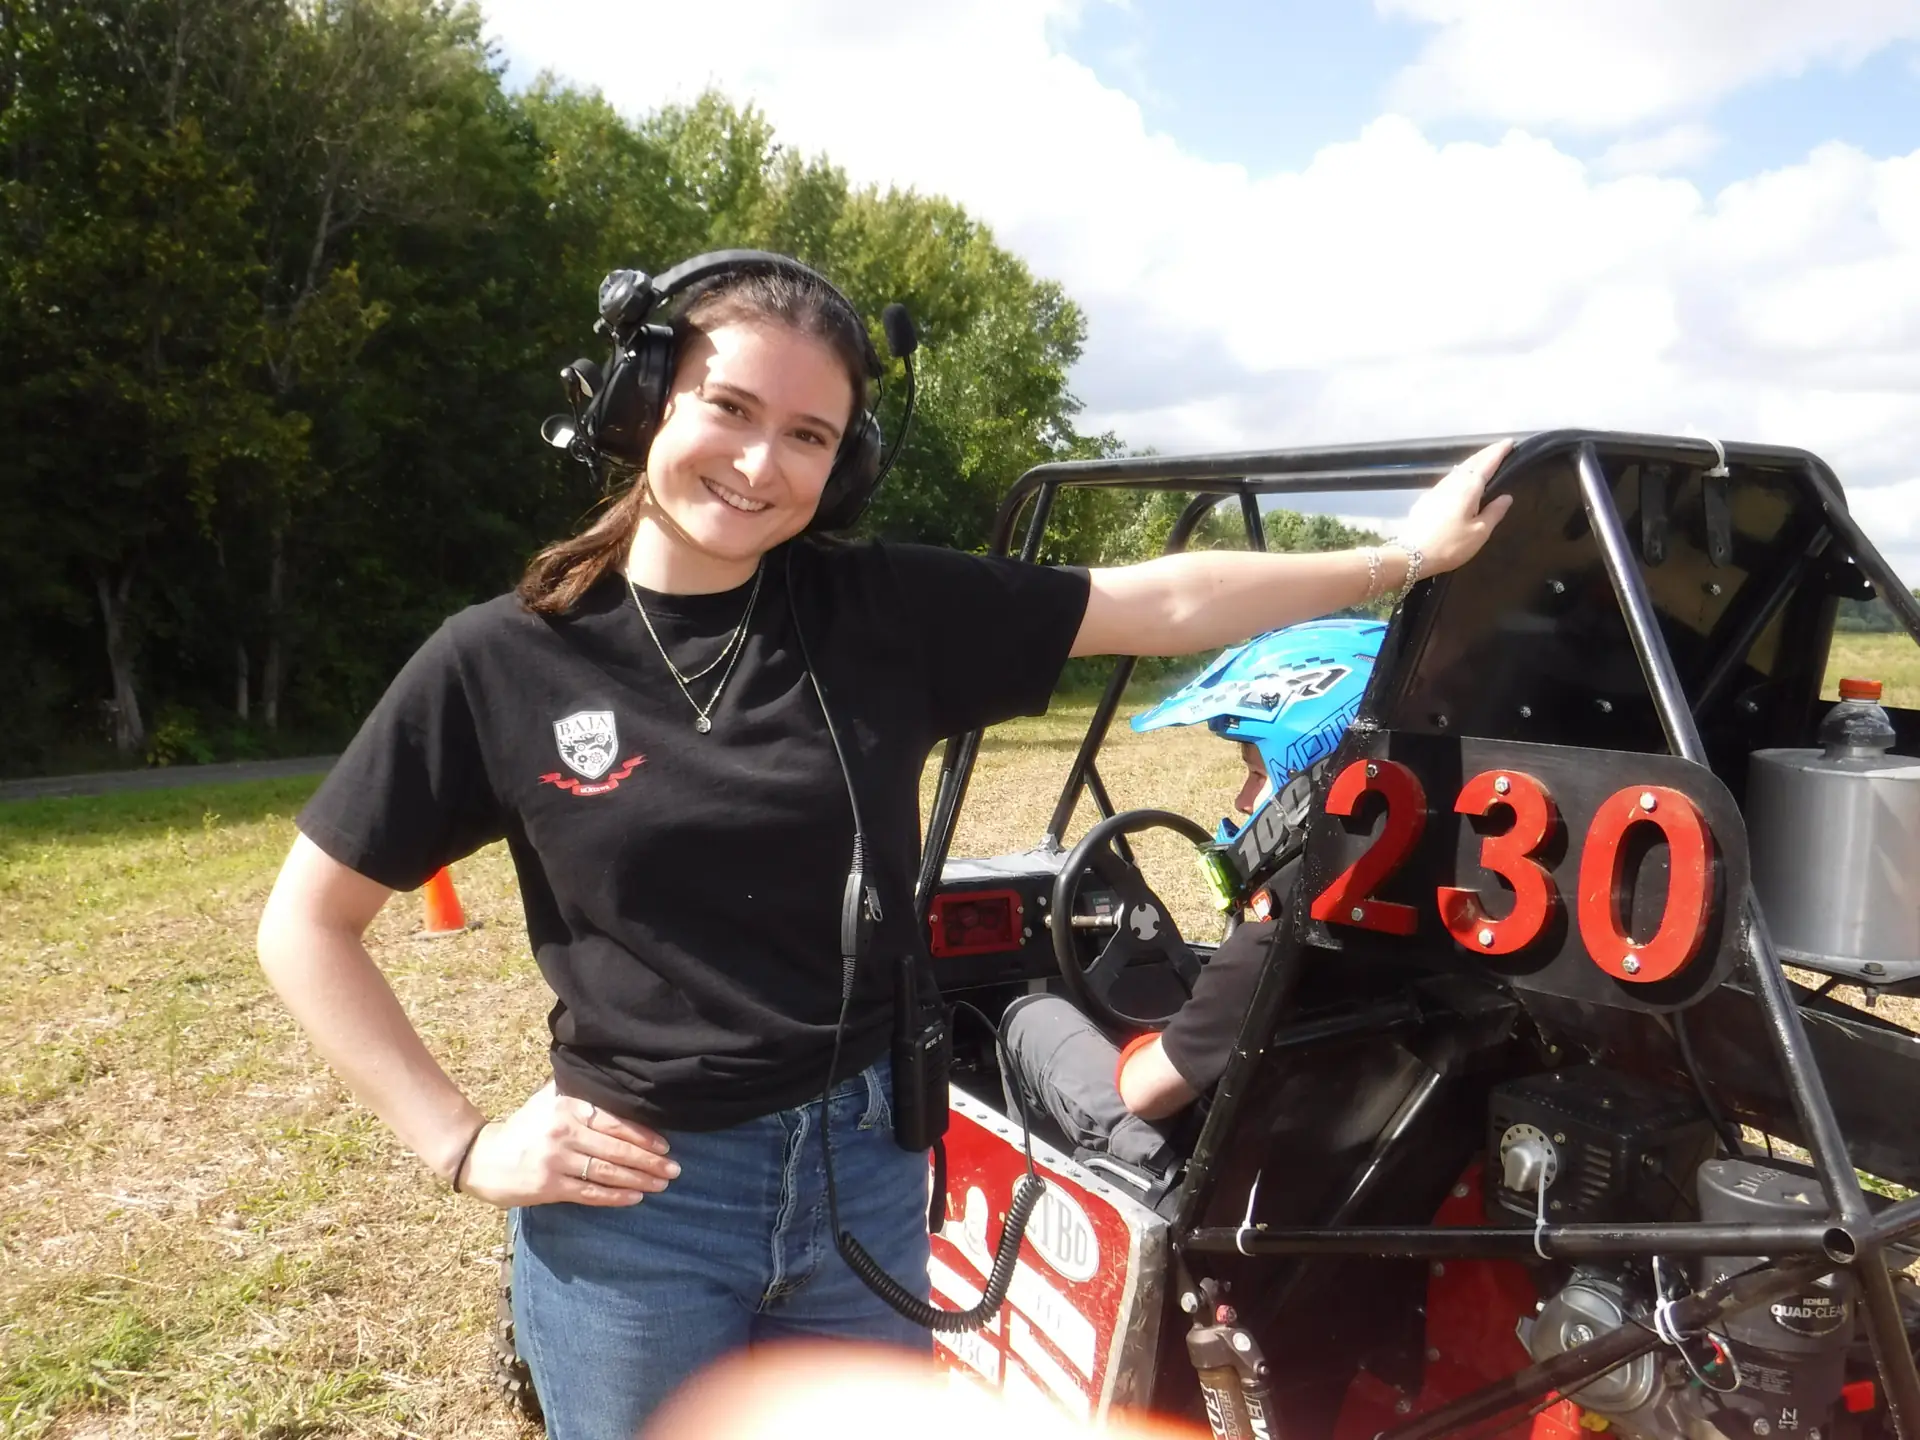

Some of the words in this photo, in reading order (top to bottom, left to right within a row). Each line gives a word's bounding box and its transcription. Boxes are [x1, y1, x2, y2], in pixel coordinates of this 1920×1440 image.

[559, 716, 608, 736] BAJA
[1310, 758, 1712, 984] 230
[1026, 1190, 1089, 1267] TBO
[1200, 1381, 1229, 1440] FO
